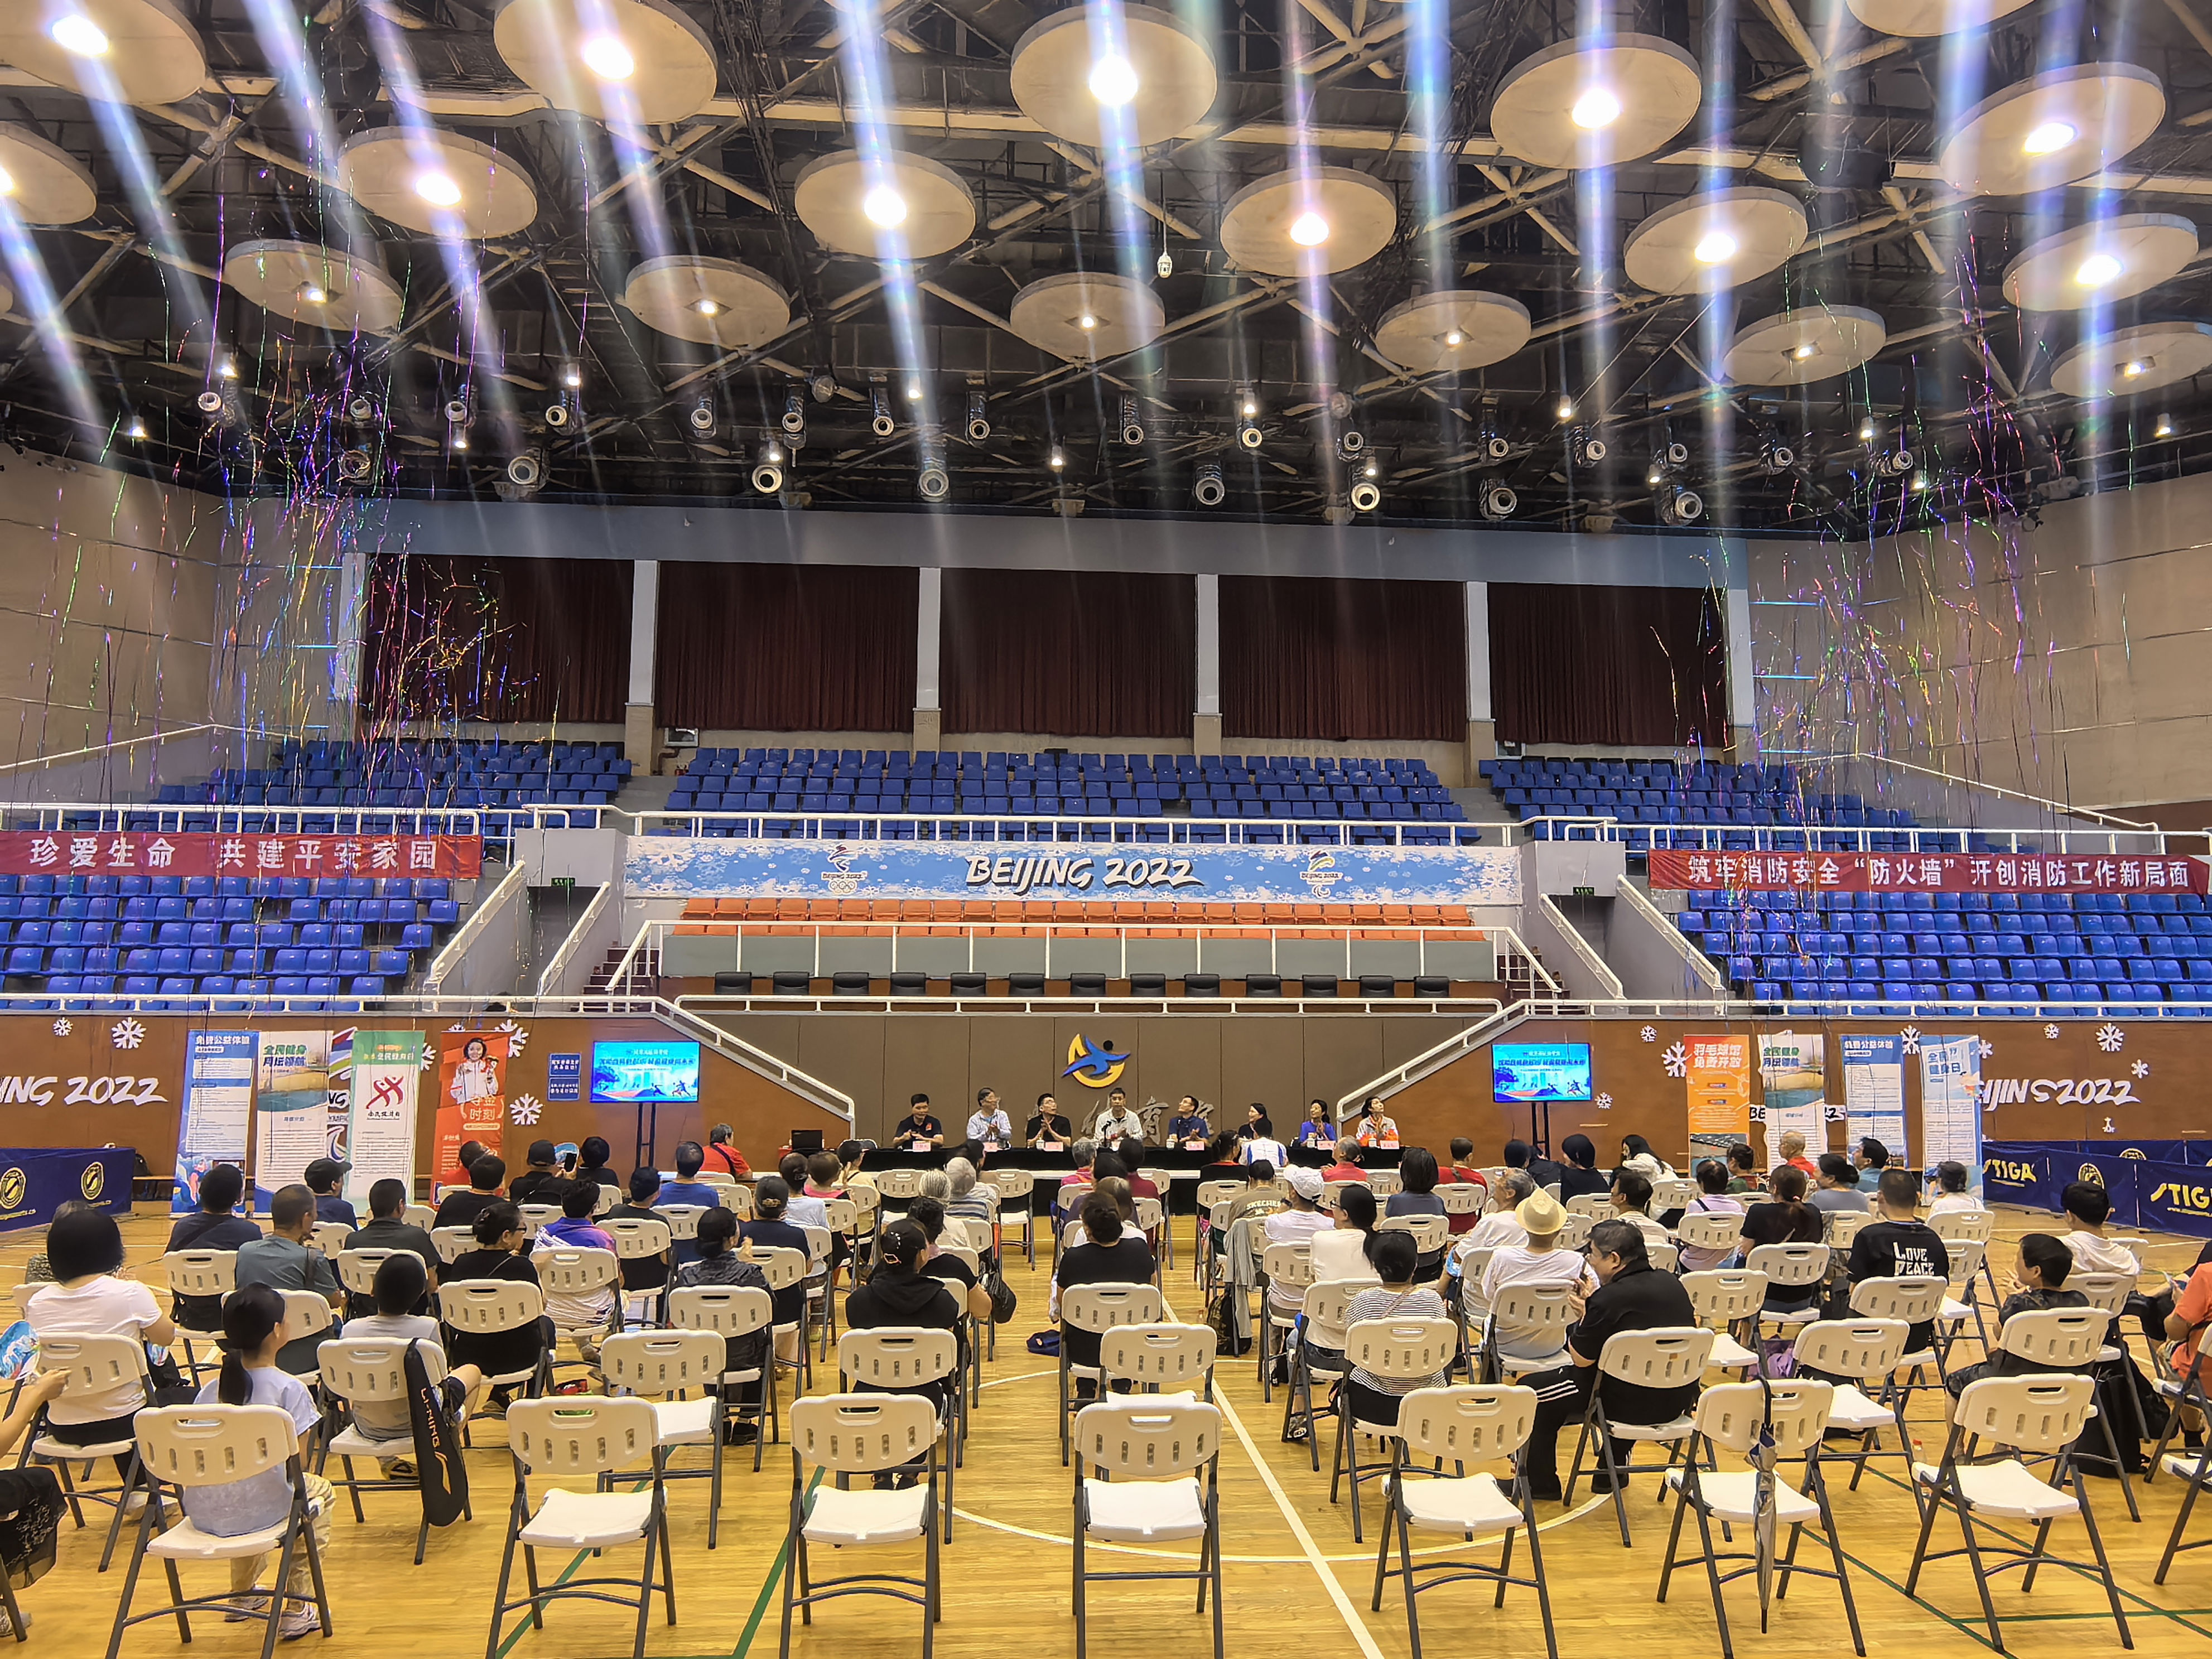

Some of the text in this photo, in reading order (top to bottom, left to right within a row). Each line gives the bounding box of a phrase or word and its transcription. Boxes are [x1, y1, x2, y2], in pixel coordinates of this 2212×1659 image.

[30, 836, 436, 870] 珍爱生命 共建平安家园
[965, 855, 1204, 895] BEIJING 2022
[1688, 855, 2189, 888] 筑牢消防安全 “防火墙” 开创消防工作新局面
[64, 1076, 168, 1106] 2022
[2056, 1079, 2141, 1106] 2022
[470, 1107, 495, 1121] 时刻
[1982, 1159, 2037, 1183] STIGA
[2151, 1183, 2212, 1210] STIG
[1893, 1242, 1927, 1261] LOVE
[1894, 1260, 1935, 1276] PEACE
[421, 1387, 441, 1449] LI-NING
